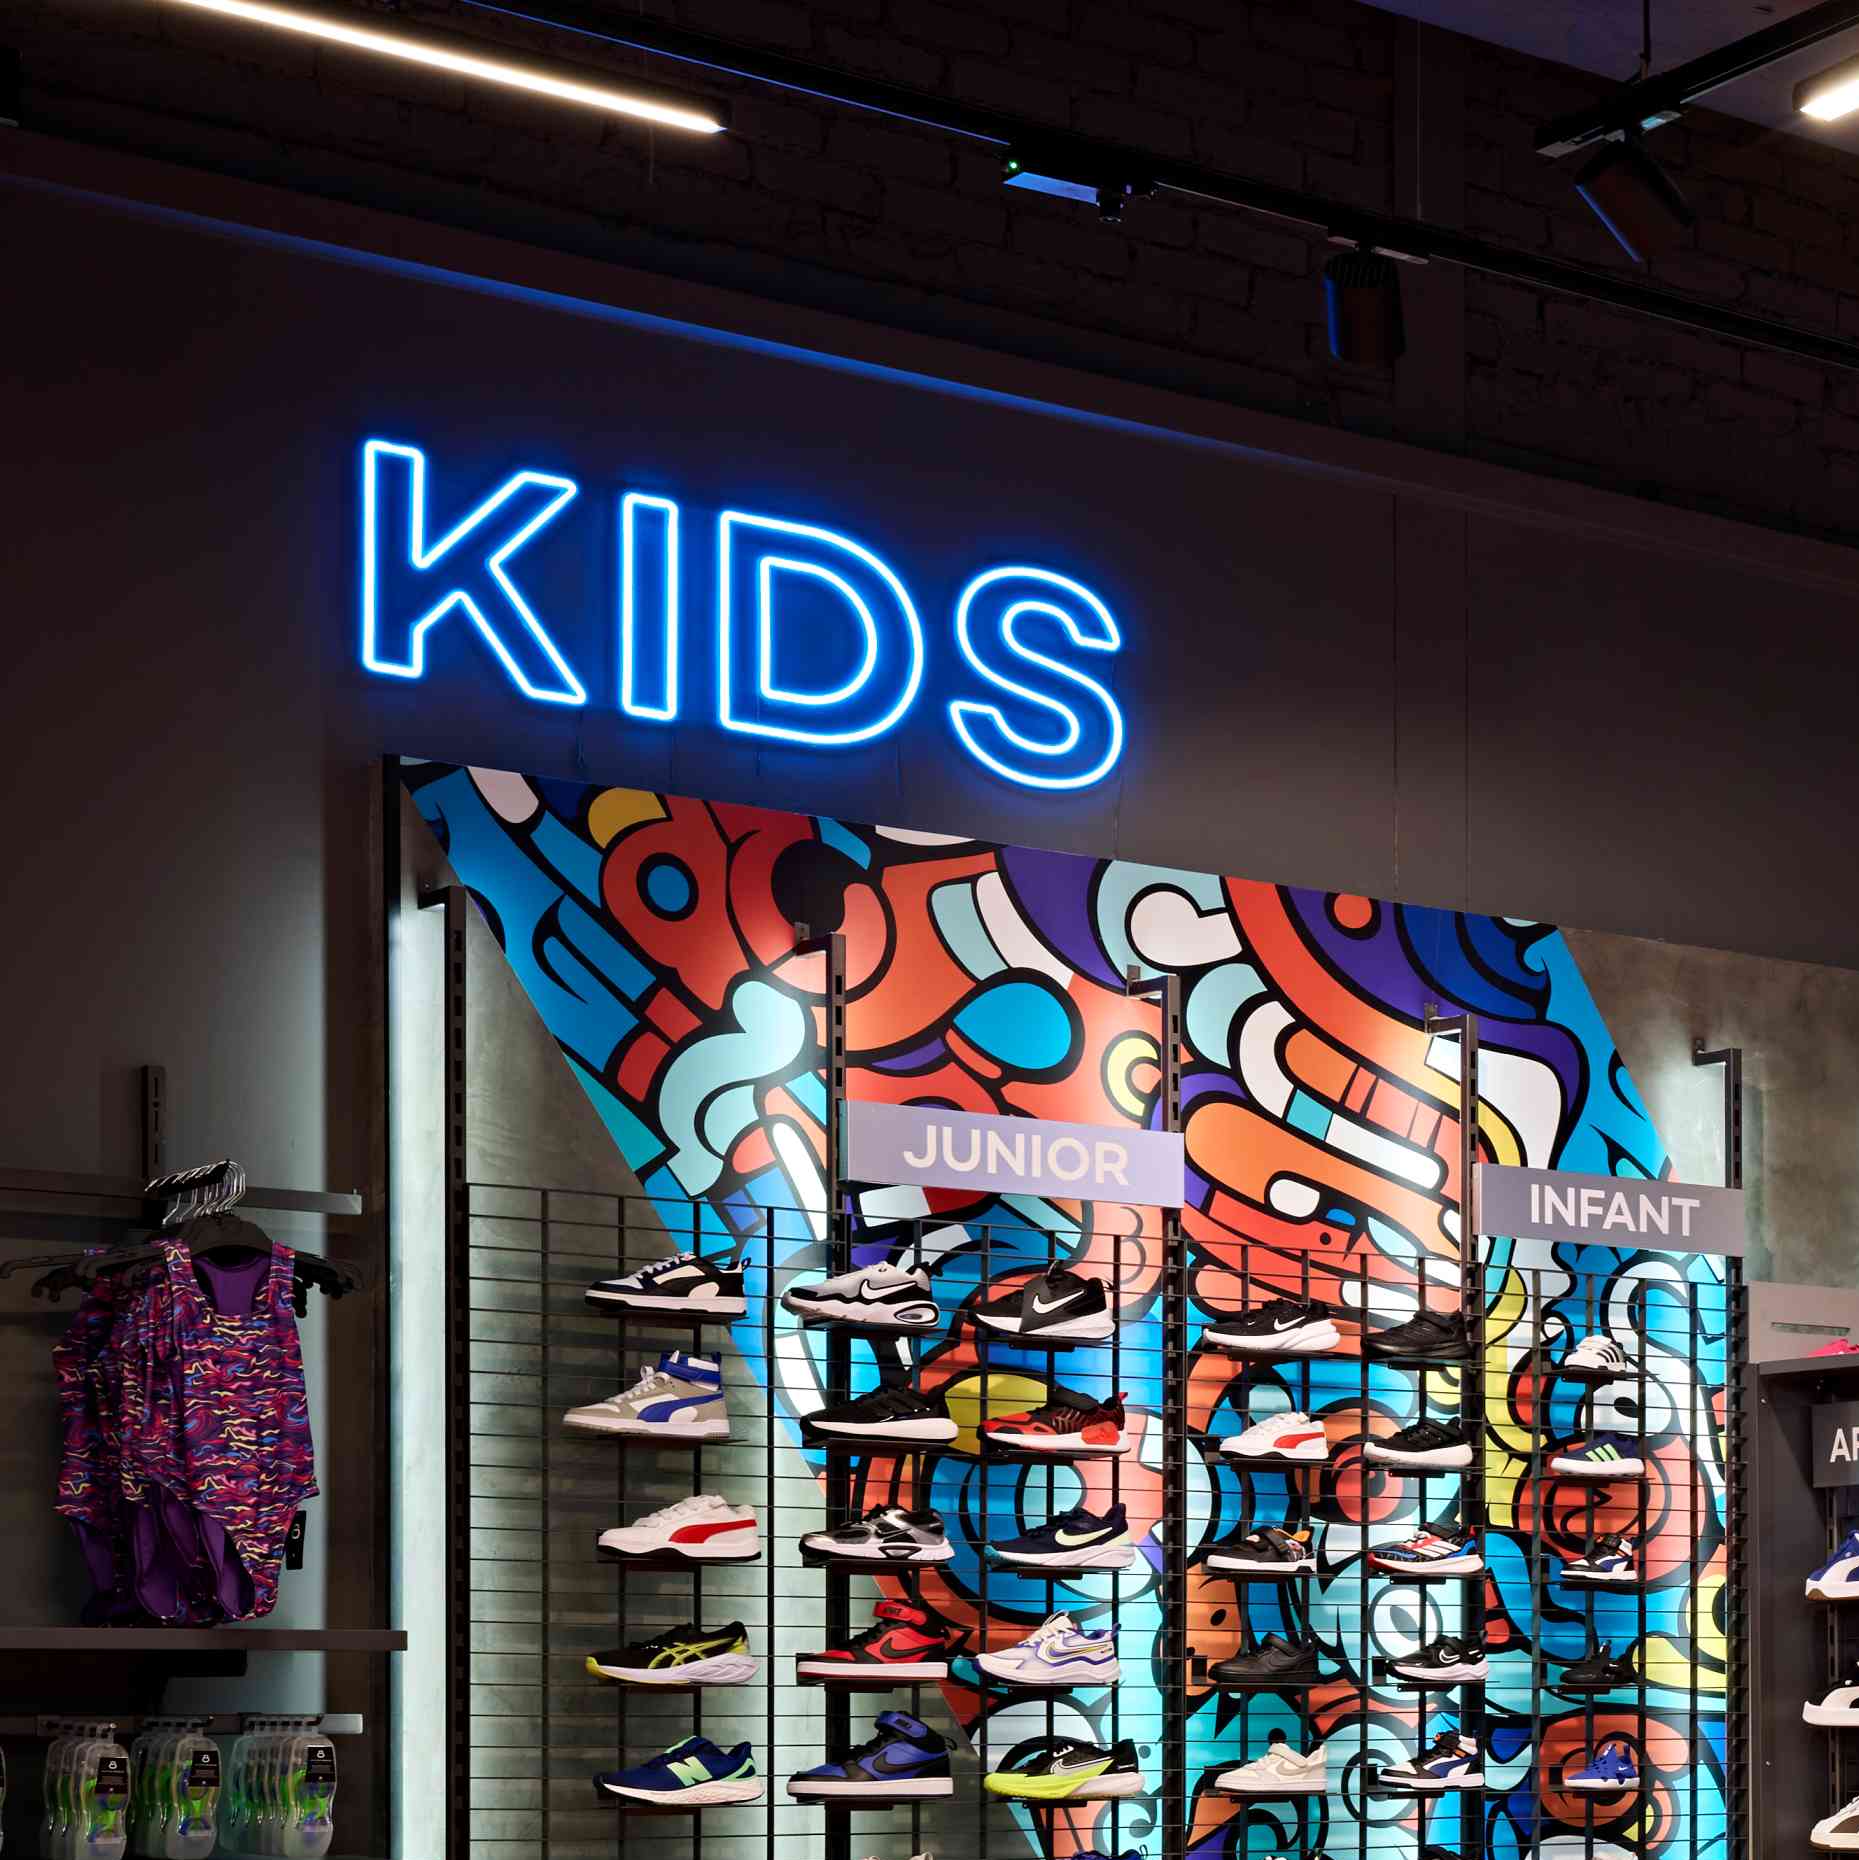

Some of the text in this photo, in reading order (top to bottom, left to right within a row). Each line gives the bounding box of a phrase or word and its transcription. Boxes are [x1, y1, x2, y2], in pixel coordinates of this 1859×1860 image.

[361, 438, 1124, 791] KIDS
[902, 1124, 1129, 1185] JUNIOR
[1529, 1182, 1701, 1237] INFANT
